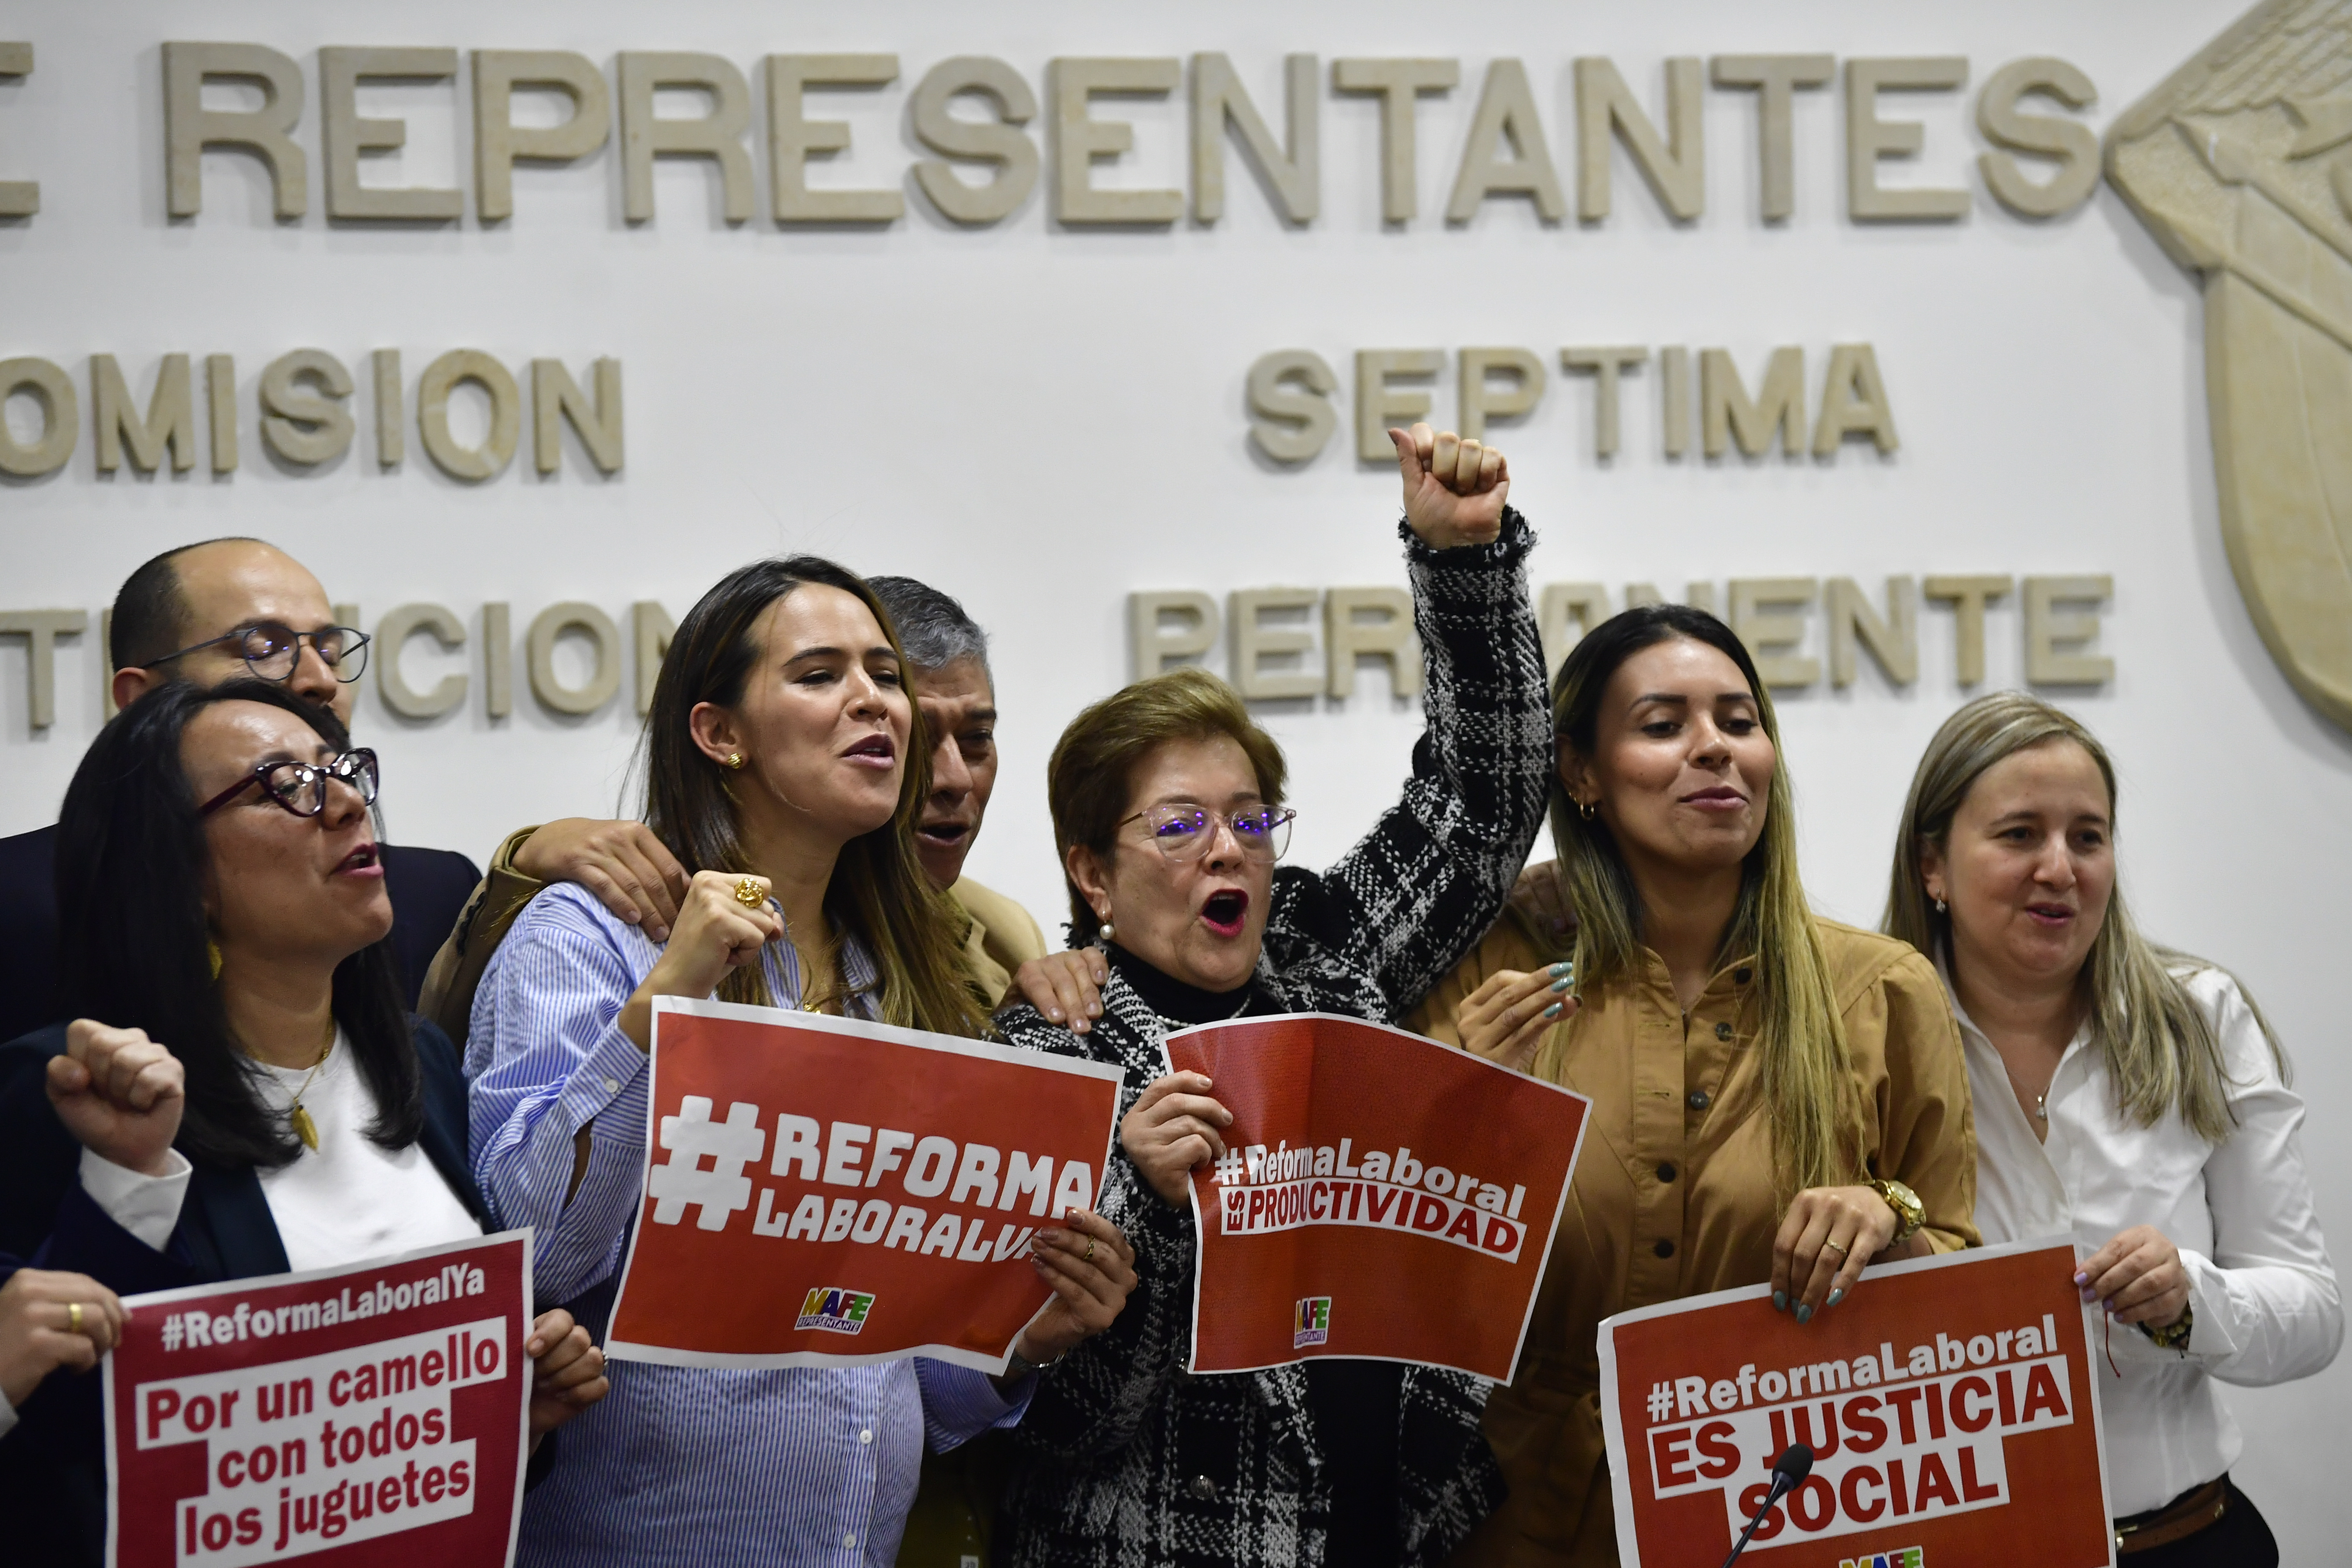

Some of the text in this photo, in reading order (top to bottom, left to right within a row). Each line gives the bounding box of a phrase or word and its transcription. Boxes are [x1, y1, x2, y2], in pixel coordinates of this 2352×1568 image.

[162, 41, 2104, 227] REPRESENTANTES
[1245, 343, 1898, 461] SEPTIMA
[1130, 574, 2113, 700] PERAENTE
[648, 1095, 1092, 1232] #REFORMA
[1215, 1138, 1526, 1220] #ReformaLaboral
[1227, 1181, 1519, 1255] ES PRODUCTIVIDAD
[161, 1262, 485, 1351] #ReformaLaboralYa
[797, 1316, 861, 1332] REPRESENTANTE
[801, 1290, 873, 1321] MAFE
[1296, 1300, 1329, 1333] MAFE
[146, 1331, 499, 1440] Por un camello
[1647, 1314, 2058, 1422] #ReformaLaboral
[218, 1406, 444, 1488] con todos
[1652, 1364, 2068, 1489] ES JUSTICIA
[184, 1459, 470, 1555] los juguetes
[1739, 1446, 1998, 1541] SOCIAL
